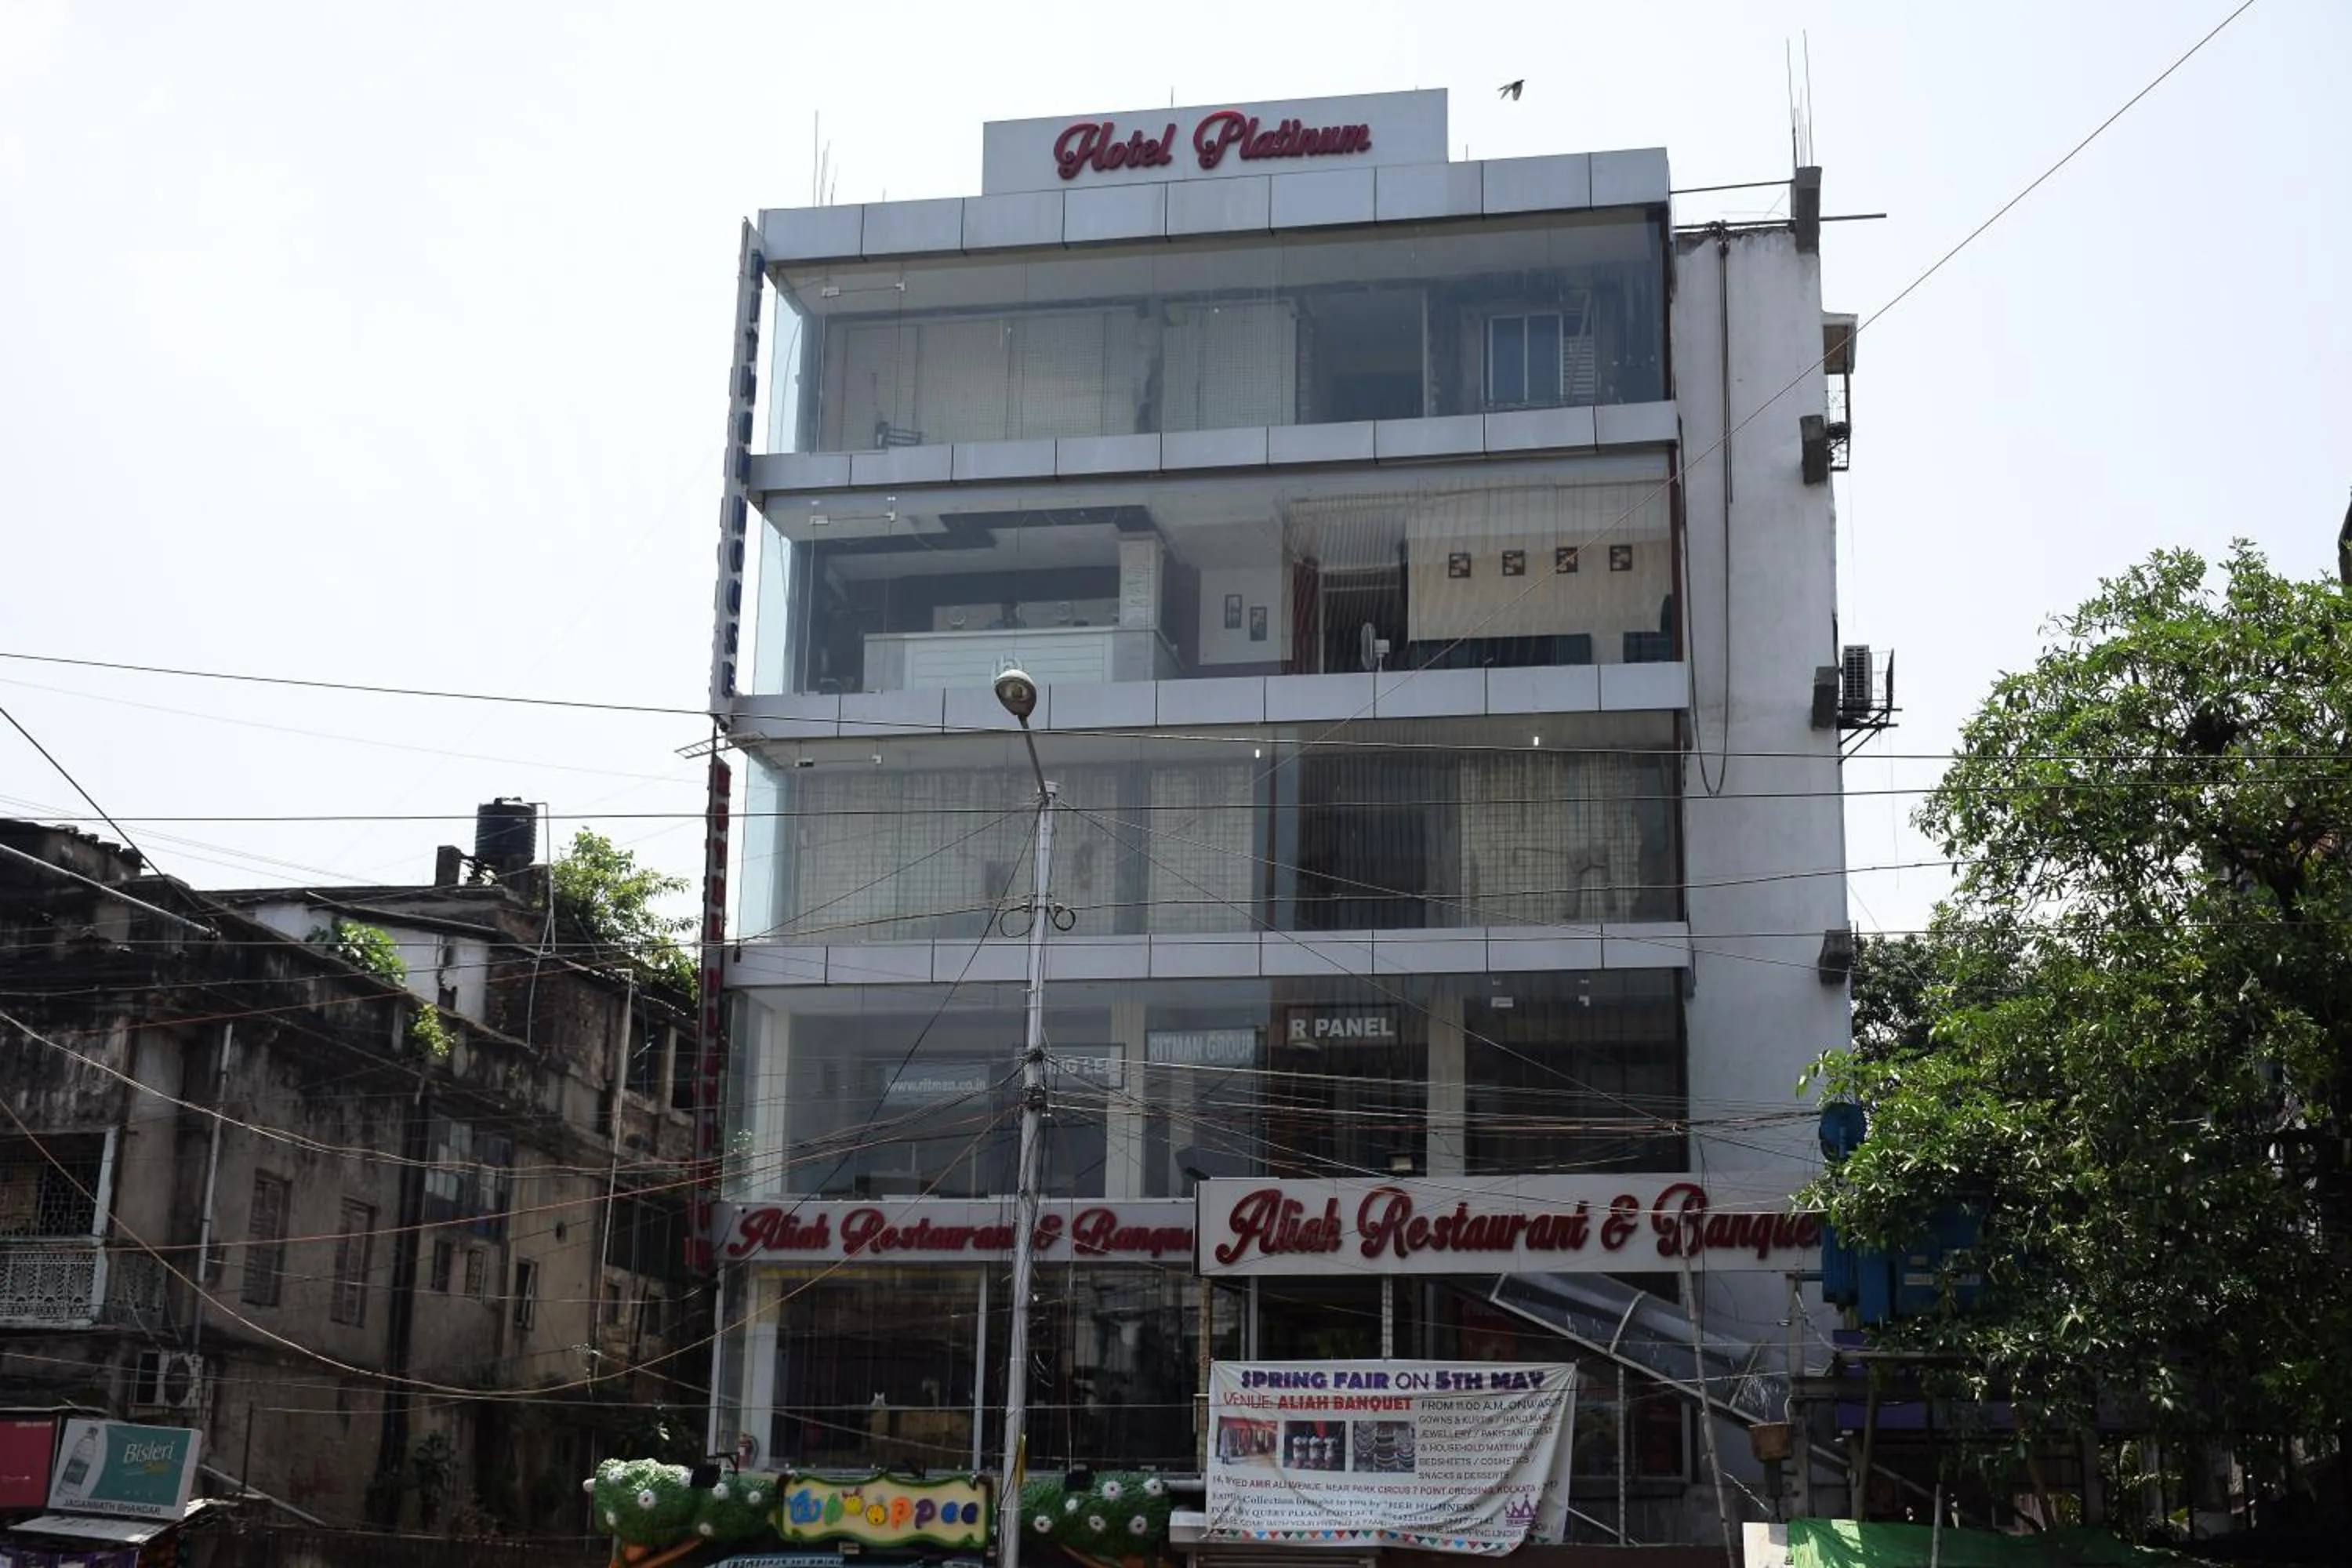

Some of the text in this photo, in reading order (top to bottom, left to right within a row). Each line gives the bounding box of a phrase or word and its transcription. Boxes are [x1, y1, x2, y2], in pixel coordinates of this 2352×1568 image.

[1054, 111, 1372, 180] Hotel Platinum
[1290, 1017, 1395, 1039] R PANEL
[1207, 1031, 1255, 1060] GROUP
[728, 1207, 830, 1256] Aliah
[840, 1207, 1015, 1254] Restauran
[1215, 1182, 1821, 1265] Aliah Restaurant & Banque
[1240, 1370, 1545, 1390] SPRING FAIR ON 5TH MAY
[1278, 1395, 1329, 1410] ALIAH
[1333, 1395, 1412, 1411] BANQUET
[1421, 1399, 1453, 1411] FROM
[122, 1442, 175, 1464] Bisleri
